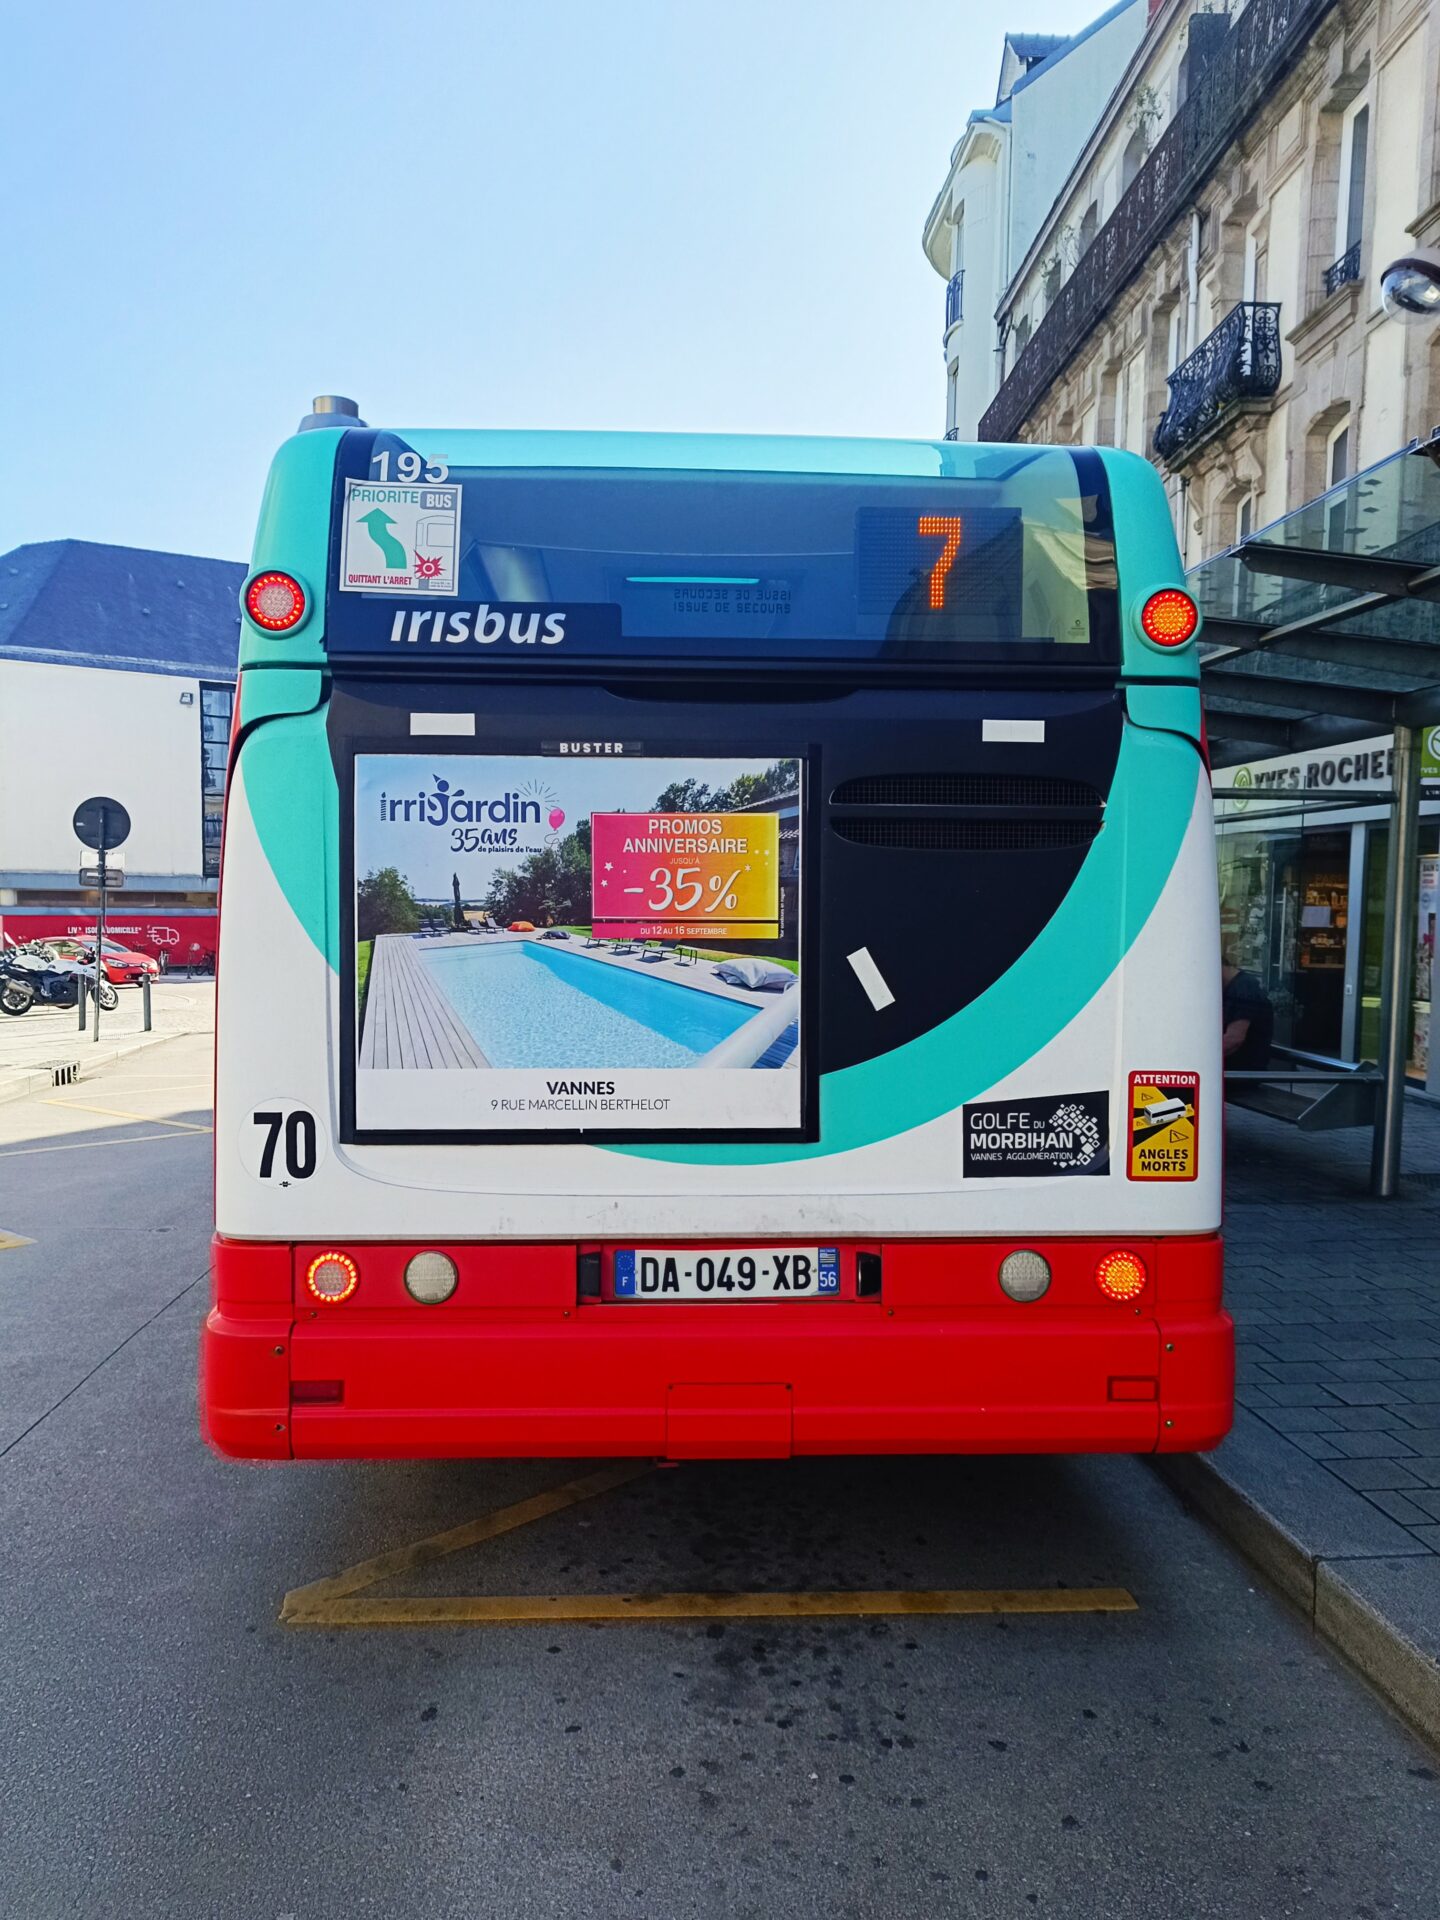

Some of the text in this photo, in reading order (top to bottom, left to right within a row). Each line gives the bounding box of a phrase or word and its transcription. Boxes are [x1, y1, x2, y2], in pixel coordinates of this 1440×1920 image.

[372, 451, 449, 483] 195
[351, 489, 452, 508] PRIORITE BUS
[918, 516, 961, 609] 7
[348, 574, 413, 585] QUITTANT L'ARRET
[673, 602, 708, 613] ISSUE
[714, 602, 730, 613] DE
[560, 743, 623, 753] BUSTER
[1254, 767, 1300, 790] YVES
[648, 819, 723, 835] PROMOS
[451, 828, 518, 852] 35 ans
[623, 838, 748, 854] ANNIVERSAIRE
[488, 846, 514, 854] plaisirs
[669, 857, 701, 865] JUSQU'À
[652, 926, 662, 935] 12
[675, 926, 685, 935] 16
[1134, 1075, 1196, 1084] ATTENTION
[546, 1081, 615, 1095] VANNES
[491, 1099, 671, 1110] 9 RUE MARCELLIN BERTHELOT
[970, 1112, 1045, 1129] GOLFE DU
[253, 1110, 316, 1179] 70
[970, 1153, 1003, 1161] VANNES
[1138, 1149, 1189, 1159] ANGLES
[1141, 1162, 1186, 1171] MORTS
[622, 1254, 837, 1292] F DA-049-XB 56
